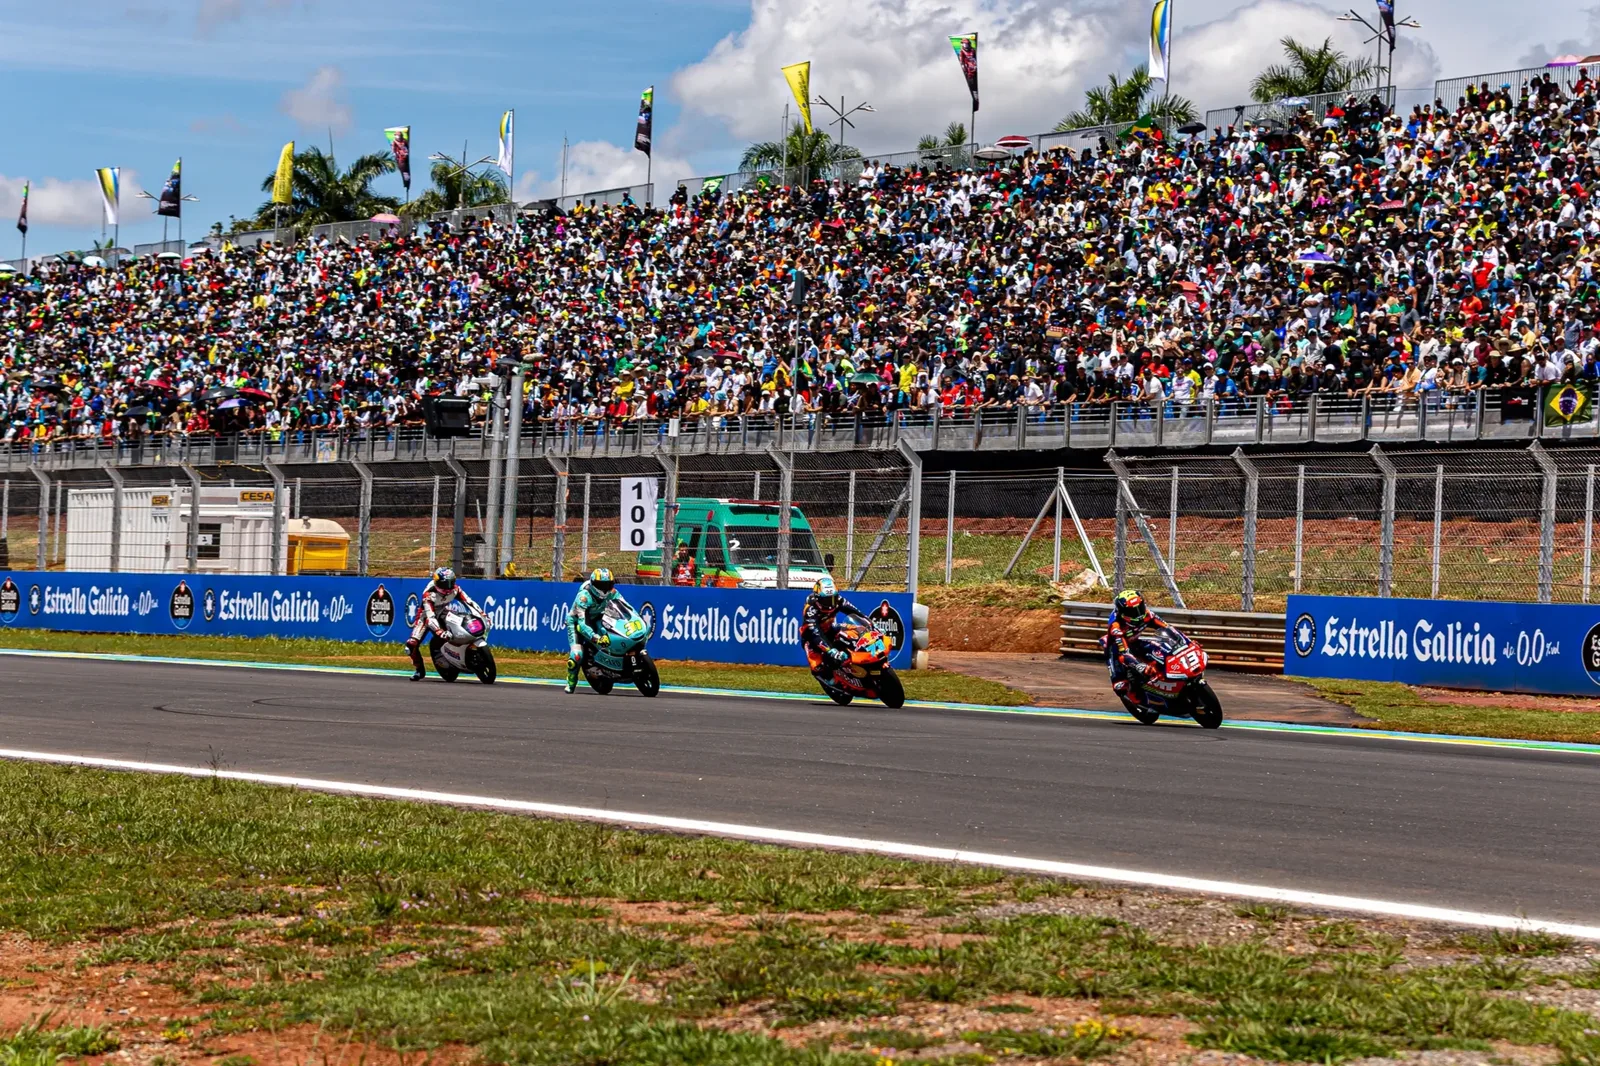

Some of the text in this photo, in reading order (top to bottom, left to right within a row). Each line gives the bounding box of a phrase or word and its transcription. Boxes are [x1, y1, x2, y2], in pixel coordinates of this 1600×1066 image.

[241, 492, 273, 501] CESA
[630, 481, 646, 547] 100
[728, 539, 741, 551] 2
[43, 586, 87, 615] Estrella
[88, 585, 129, 616] Galicia
[218, 589, 269, 621] Estrella
[270, 589, 320, 622] Galicia
[370, 598, 391, 611] Estrella
[483, 595, 538, 632] Galicia
[371, 611, 389, 623] Galicia
[660, 603, 730, 642] Estrella
[734, 605, 800, 645] Galicia
[1320, 615, 1408, 660] Estrella
[1413, 618, 1496, 666] Galicia
[1516, 628, 1545, 667] 0,0
[1180, 651, 1200, 670] 13
